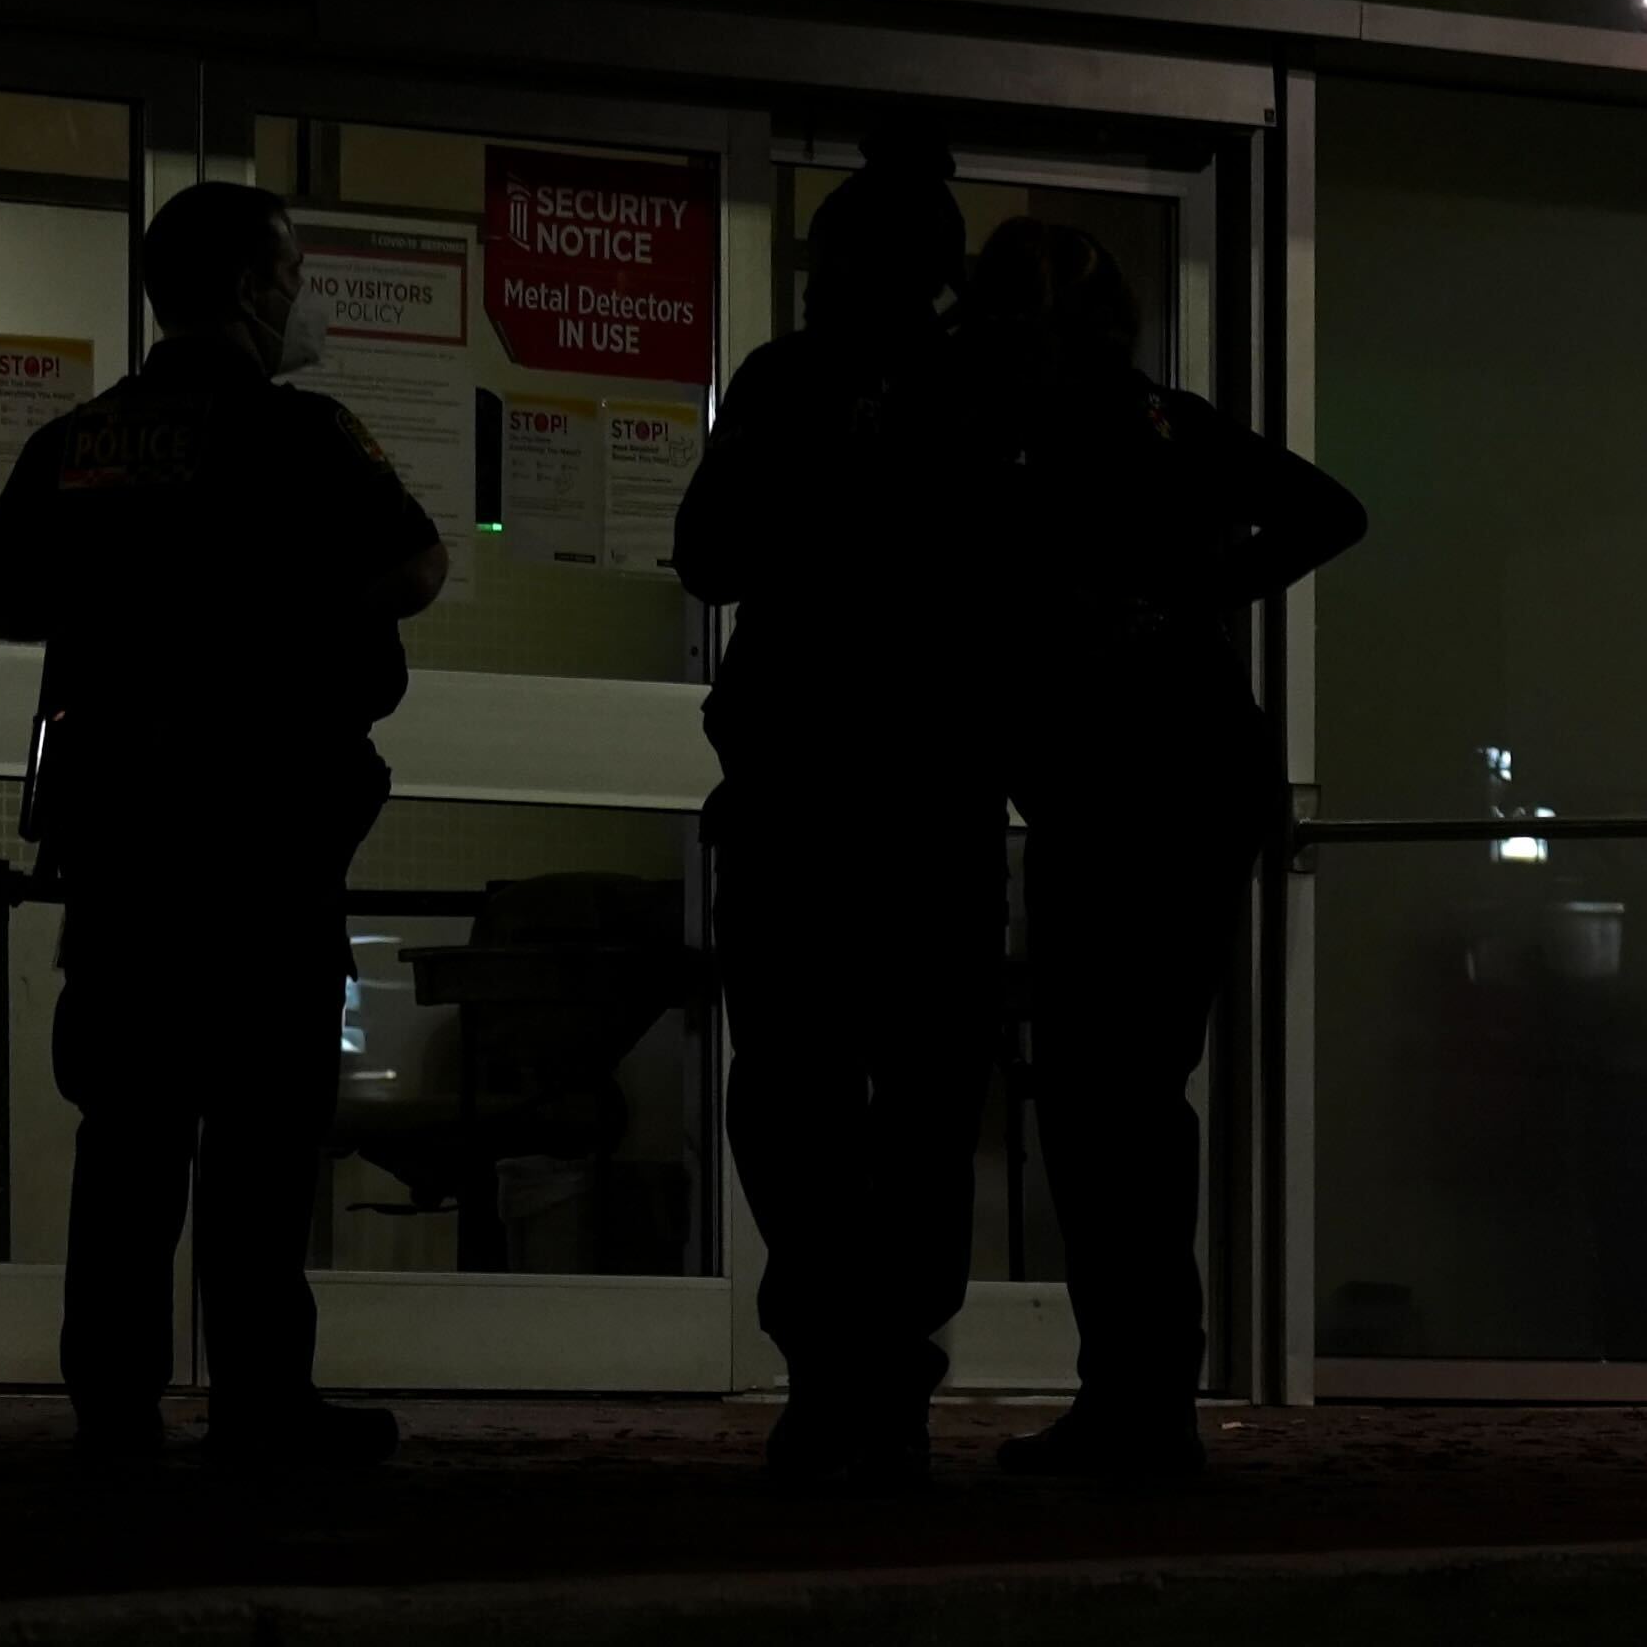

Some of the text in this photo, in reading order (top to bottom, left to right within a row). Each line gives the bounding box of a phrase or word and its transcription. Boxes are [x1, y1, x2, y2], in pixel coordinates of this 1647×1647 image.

[536, 185, 689, 231] SECURITY
[536, 221, 653, 264] NOTICE
[309, 275, 434, 305] NO VISITORS
[503, 277, 695, 326] Metal Detectors
[335, 300, 405, 324] POLICY
[557, 317, 642, 355] IN USE
[509, 411, 568, 434] STOP!
[611, 418, 669, 442] STOP!
[73, 424, 192, 467] POLICE
